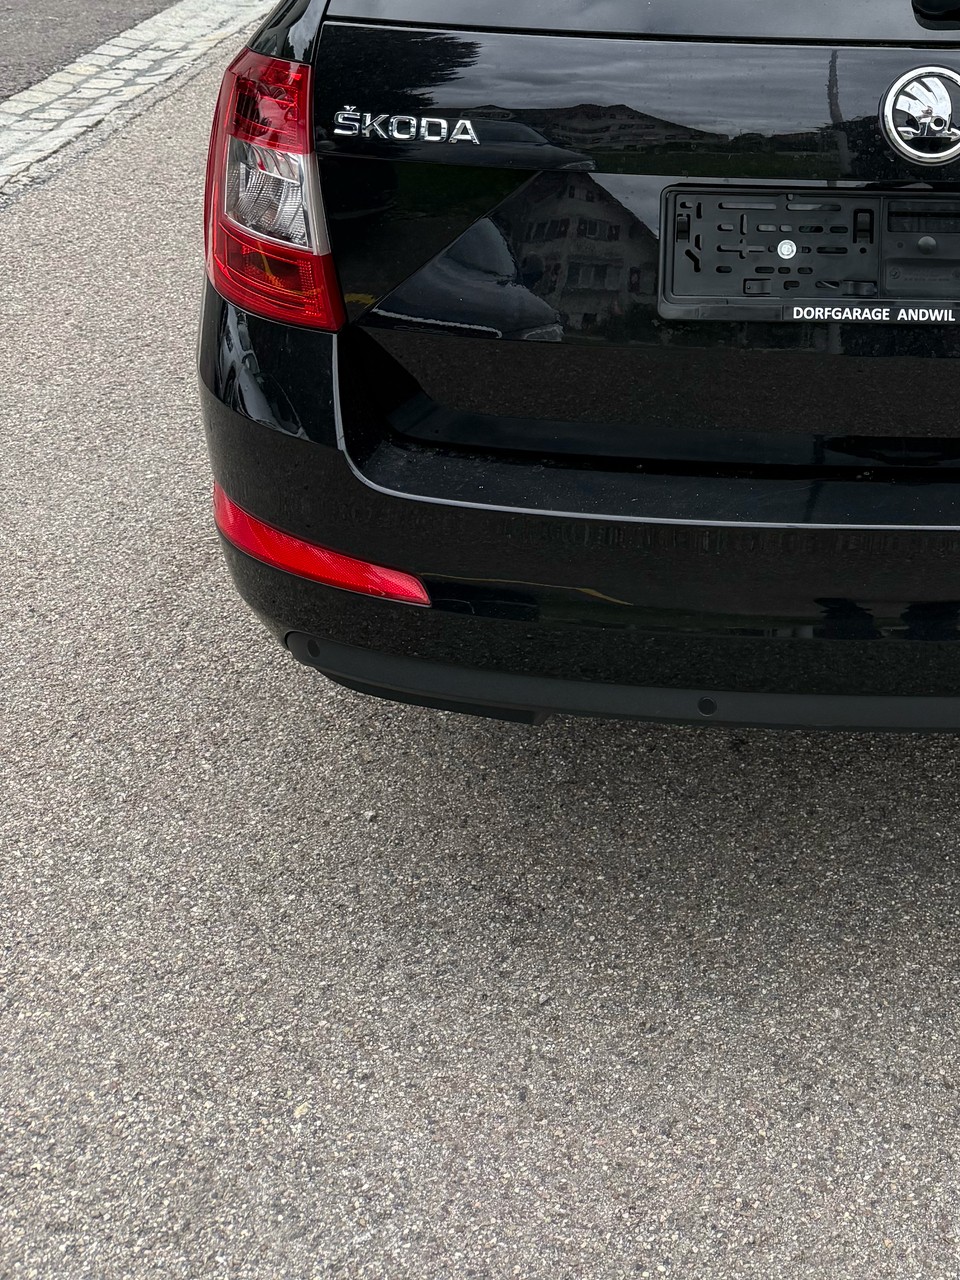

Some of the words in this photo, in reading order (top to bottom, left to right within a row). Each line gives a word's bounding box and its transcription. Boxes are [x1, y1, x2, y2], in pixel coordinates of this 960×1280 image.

[333, 105, 481, 145] ŠKODA
[792, 306, 891, 320] DORFGARAGE
[897, 308, 956, 321] ANDWIL
